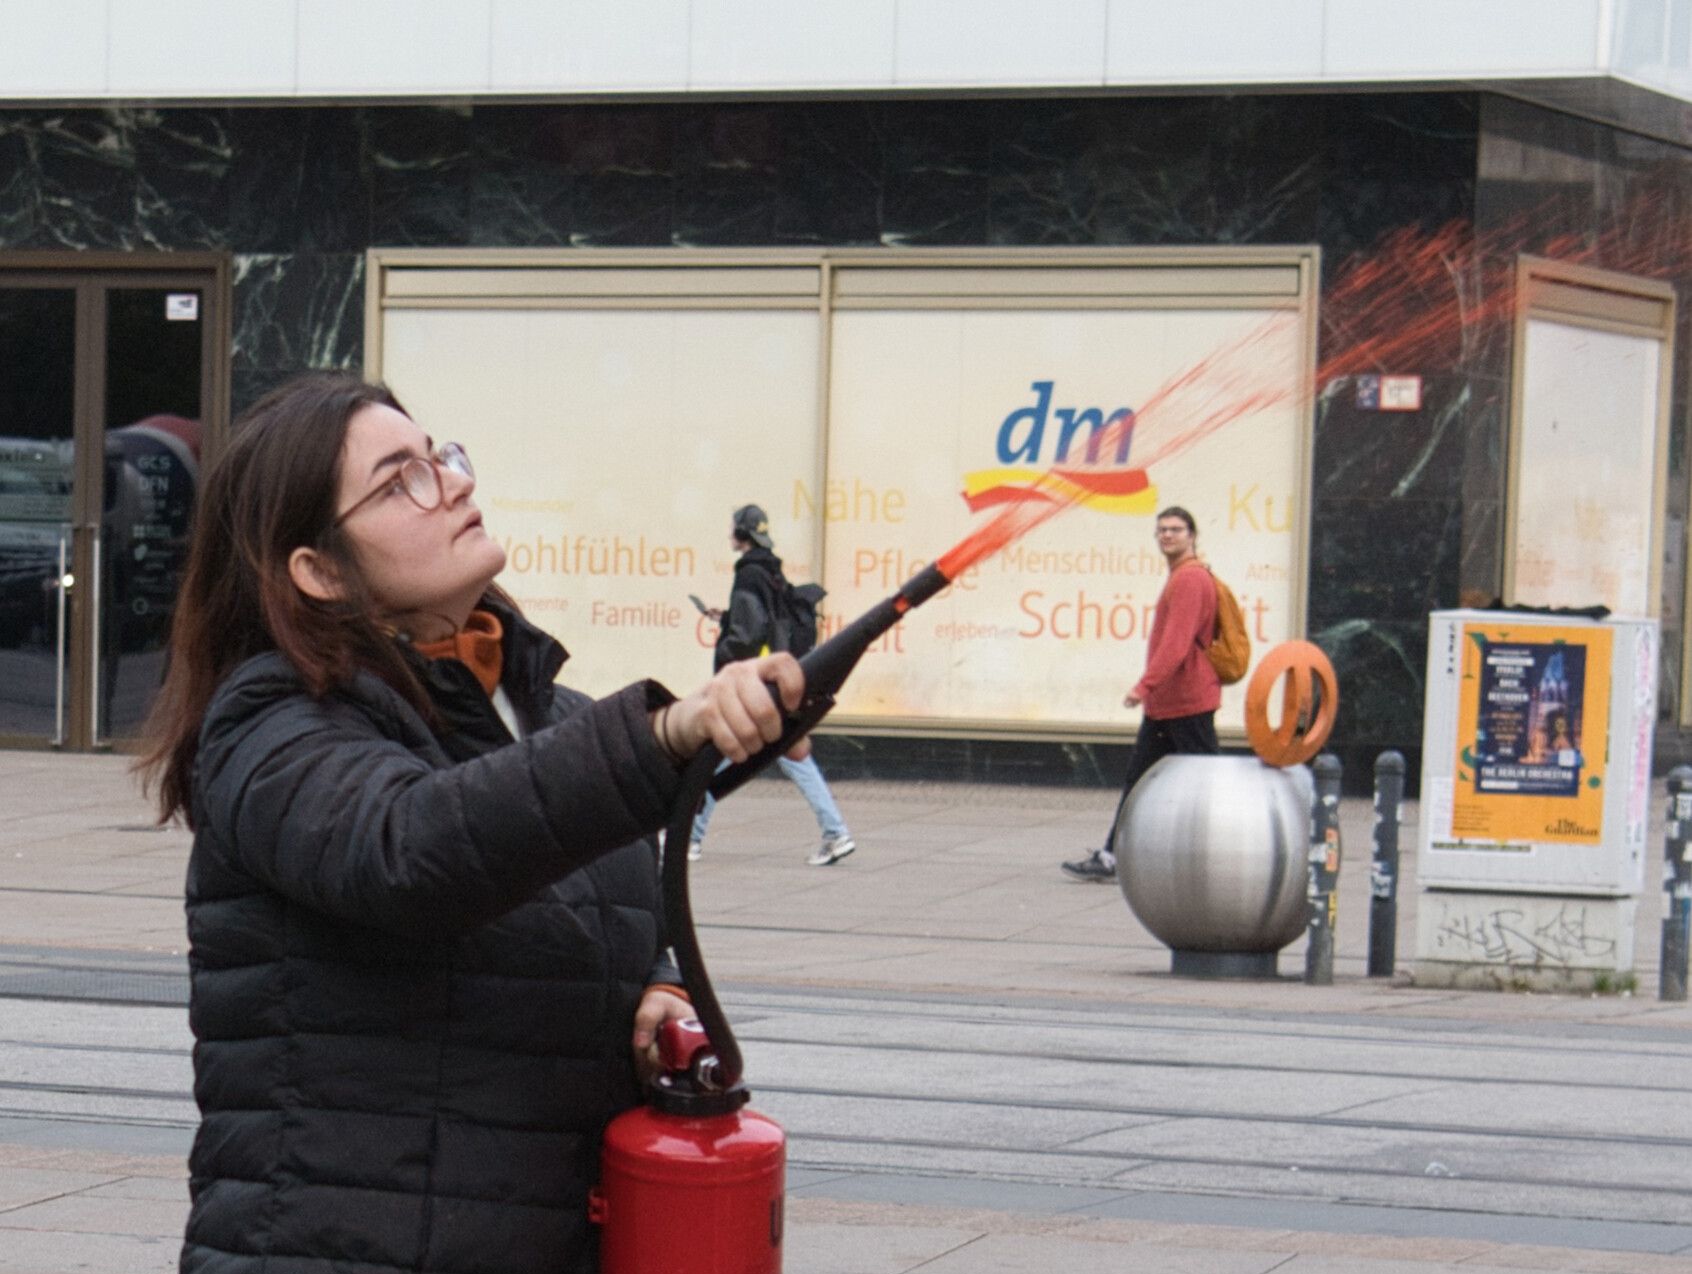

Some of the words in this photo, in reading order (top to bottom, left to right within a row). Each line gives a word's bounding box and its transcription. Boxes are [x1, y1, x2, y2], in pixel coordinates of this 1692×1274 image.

[996, 380, 1136, 465] dm
[792, 479, 906, 523] Nähe
[591, 600, 682, 628] Familie
[934, 621, 999, 641] erleben
